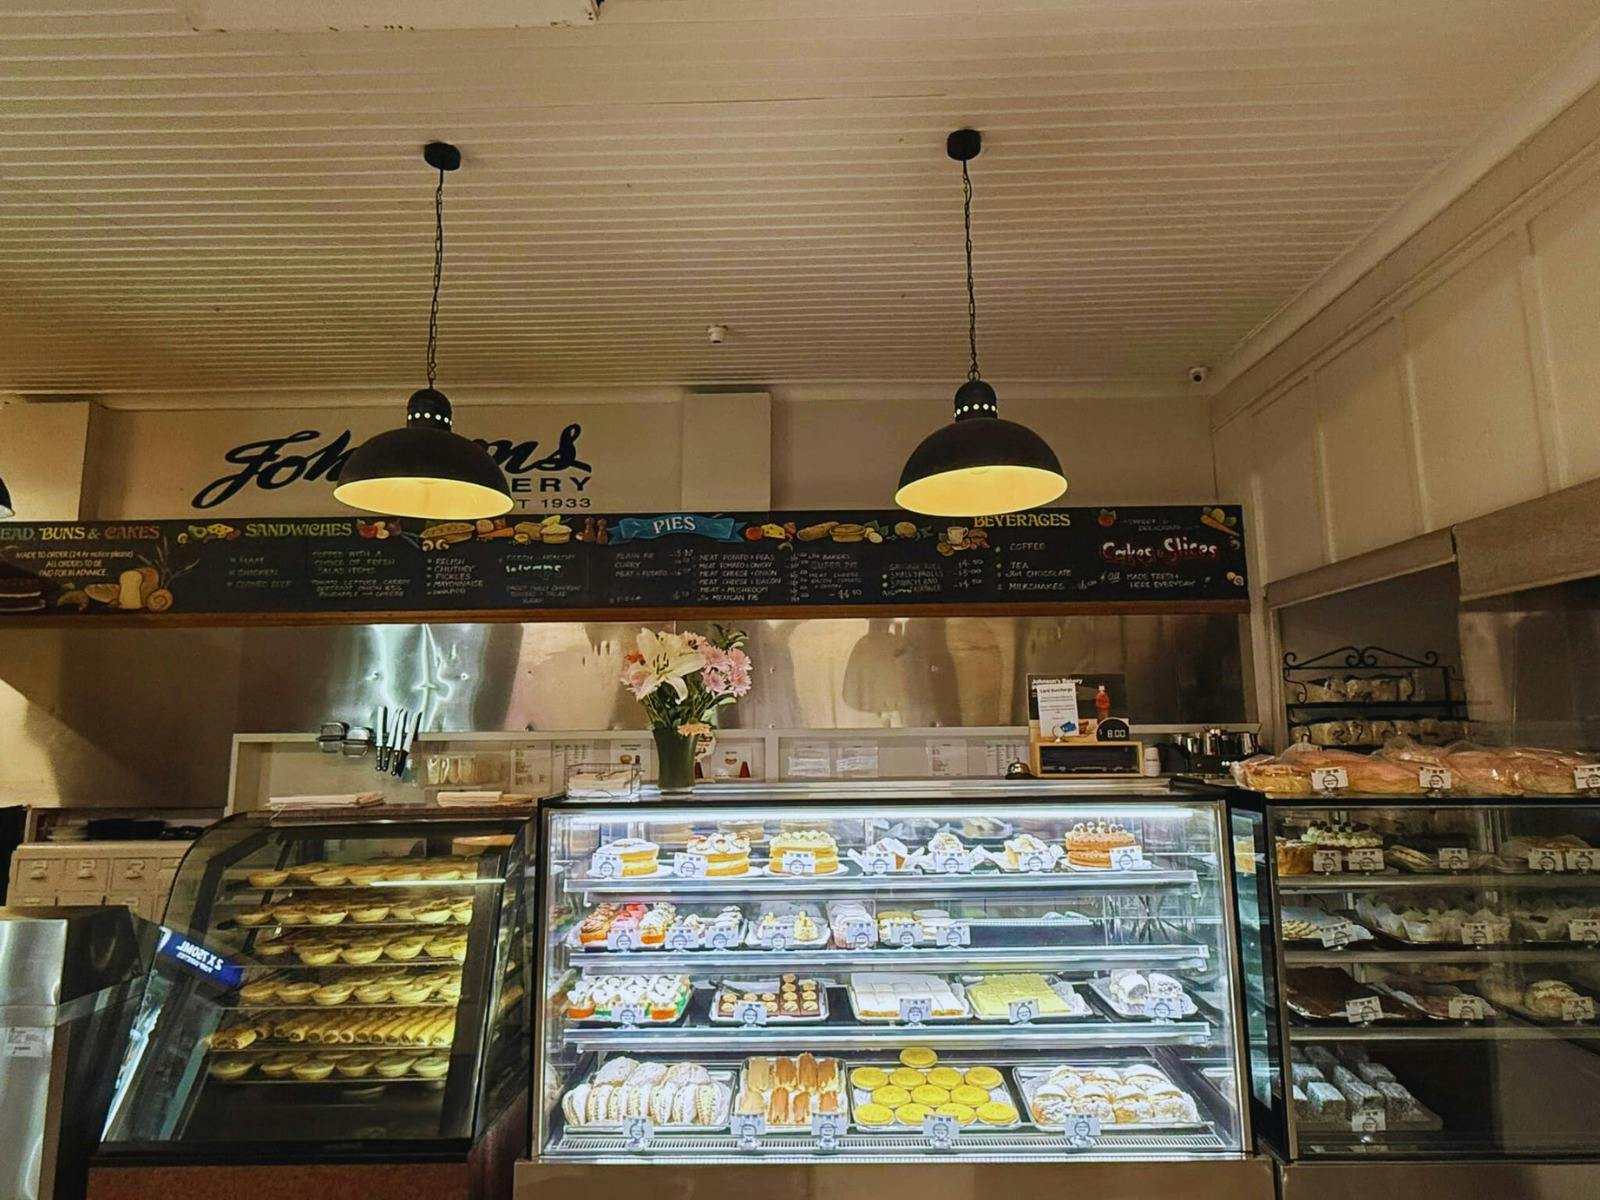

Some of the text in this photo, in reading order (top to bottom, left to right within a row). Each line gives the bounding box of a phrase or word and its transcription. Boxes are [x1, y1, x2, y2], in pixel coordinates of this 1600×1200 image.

[511, 477, 592, 493] ERY
[541, 498, 591, 509] 1933
[653, 516, 696, 534] PIES
[973, 513, 1071, 528] BEVERAGES
[40, 526, 86, 540] BUNS
[87, 527, 101, 540] &
[104, 526, 160, 540] CAKES
[245, 523, 352, 537] SANDWICHES
[1009, 542, 1046, 551] COFFEE
[1163, 536, 1218, 561] Slices
[16, 550, 37, 559] MADE
[700, 553, 719, 561] MEAT
[435, 558, 465, 566] RELISH
[614, 561, 641, 570] CURRY
[699, 561, 717, 569] MEAT
[1010, 561, 1030, 569] TEA
[433, 565, 476, 573] CHUTNEY
[699, 569, 719, 577] MEAT
[722, 569, 748, 577] CHEESE
[1025, 568, 1073, 578] CHOCOLATE
[435, 573, 472, 581] PICKLES
[699, 578, 718, 586] MEAT
[1008, 582, 1066, 591] MILKSHAKES
